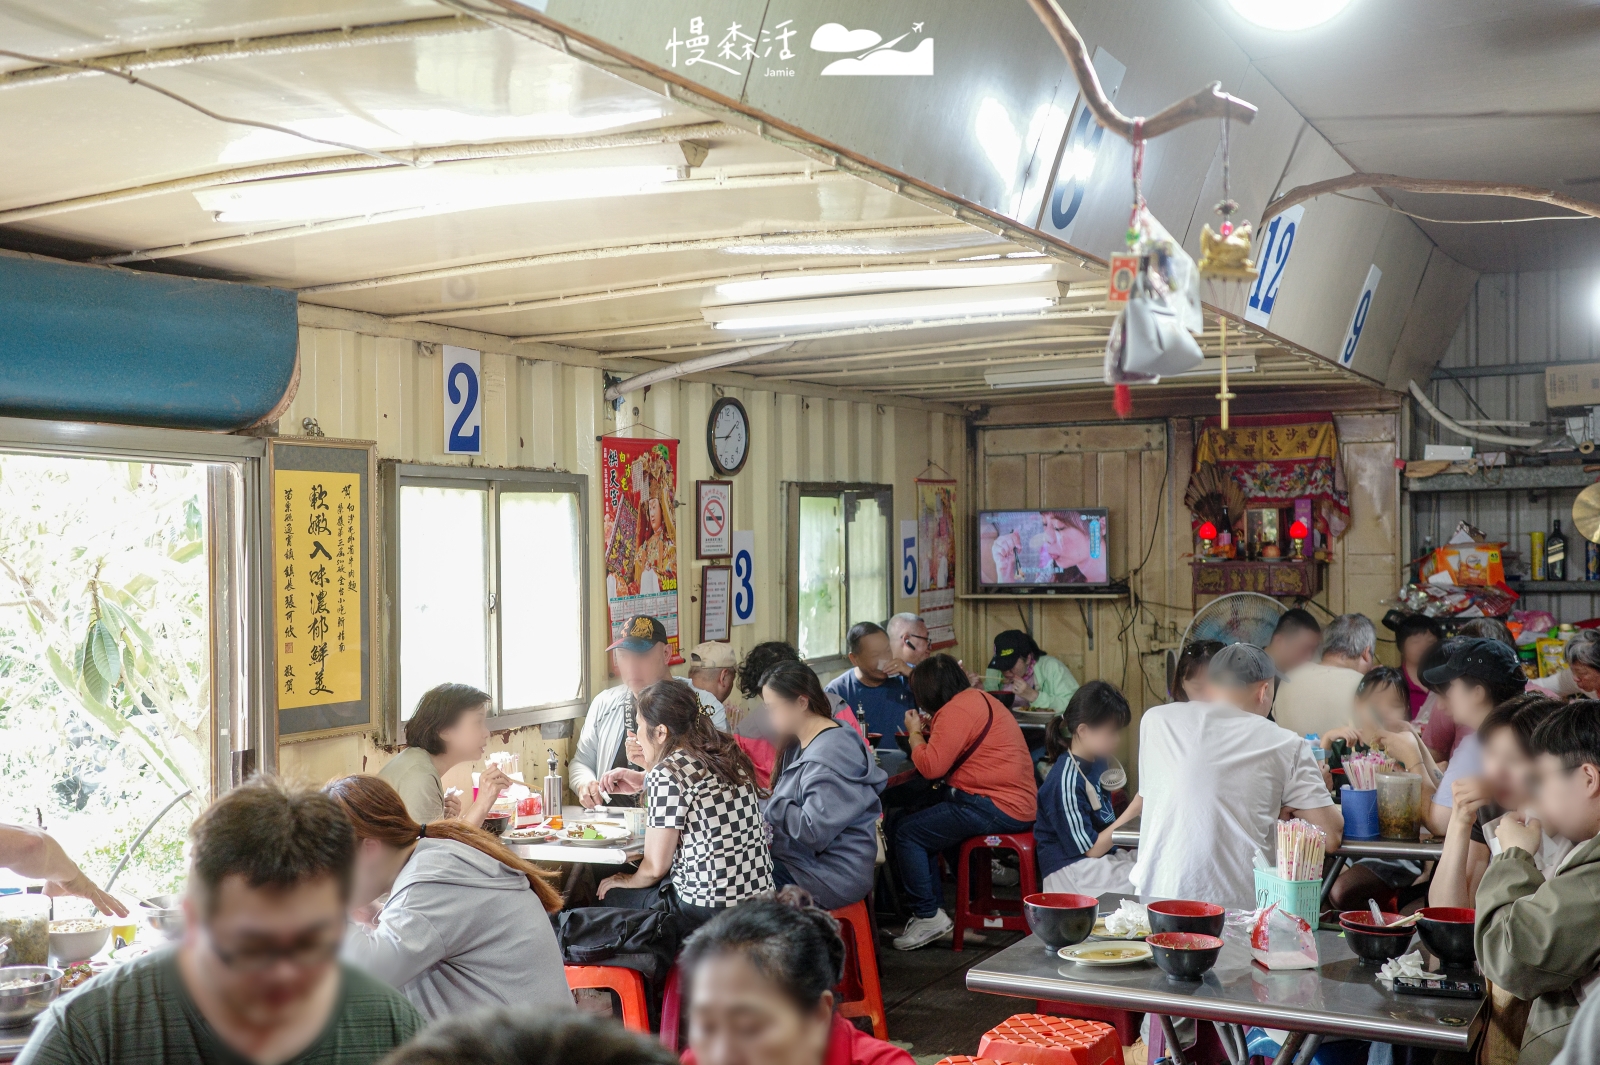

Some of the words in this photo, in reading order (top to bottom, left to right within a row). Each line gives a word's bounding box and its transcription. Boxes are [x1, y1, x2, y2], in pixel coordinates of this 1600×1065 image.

[1248, 216, 1296, 315] 12
[1343, 289, 1372, 364] 9
[447, 362, 480, 452] 2
[662, 578, 677, 590] 2026
[735, 549, 754, 620] 3
[903, 536, 917, 595] 5
